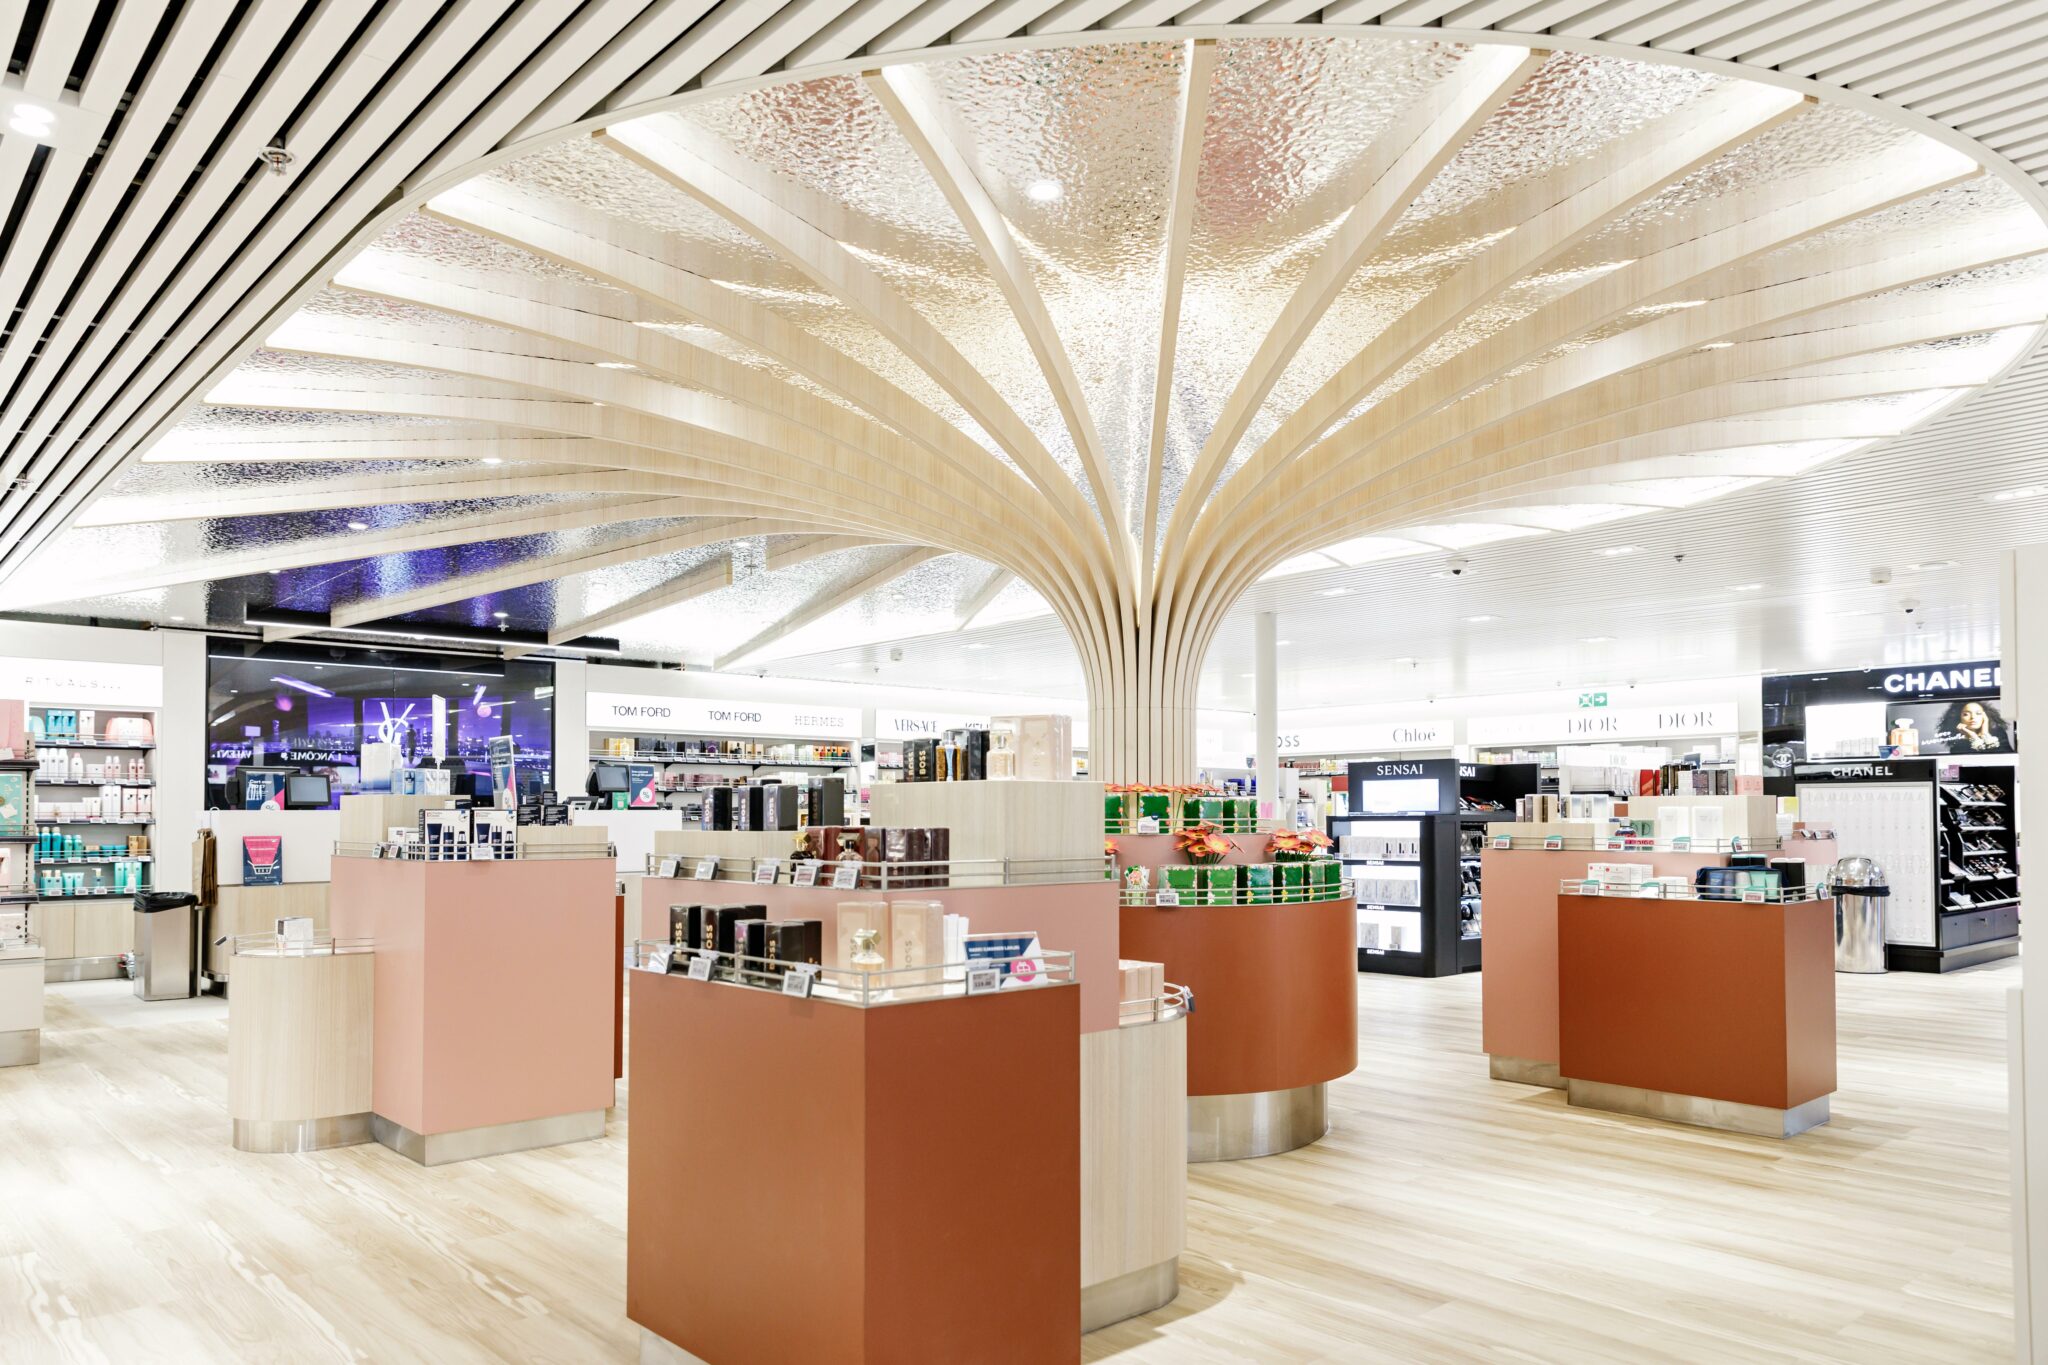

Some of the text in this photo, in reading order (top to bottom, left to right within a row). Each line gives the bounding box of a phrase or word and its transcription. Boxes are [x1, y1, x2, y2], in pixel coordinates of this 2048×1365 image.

[612, 705, 671, 718] TOM FORD
[708, 710, 762, 723] TOM FORD
[894, 718, 937, 733] VERSACE
[1568, 717, 1617, 734] DIOR
[1659, 711, 1712, 729] DIOR
[1392, 728, 1436, 743] Chloé
[1376, 763, 1424, 776] SENSAI
[1831, 766, 1893, 777] CHANEL
